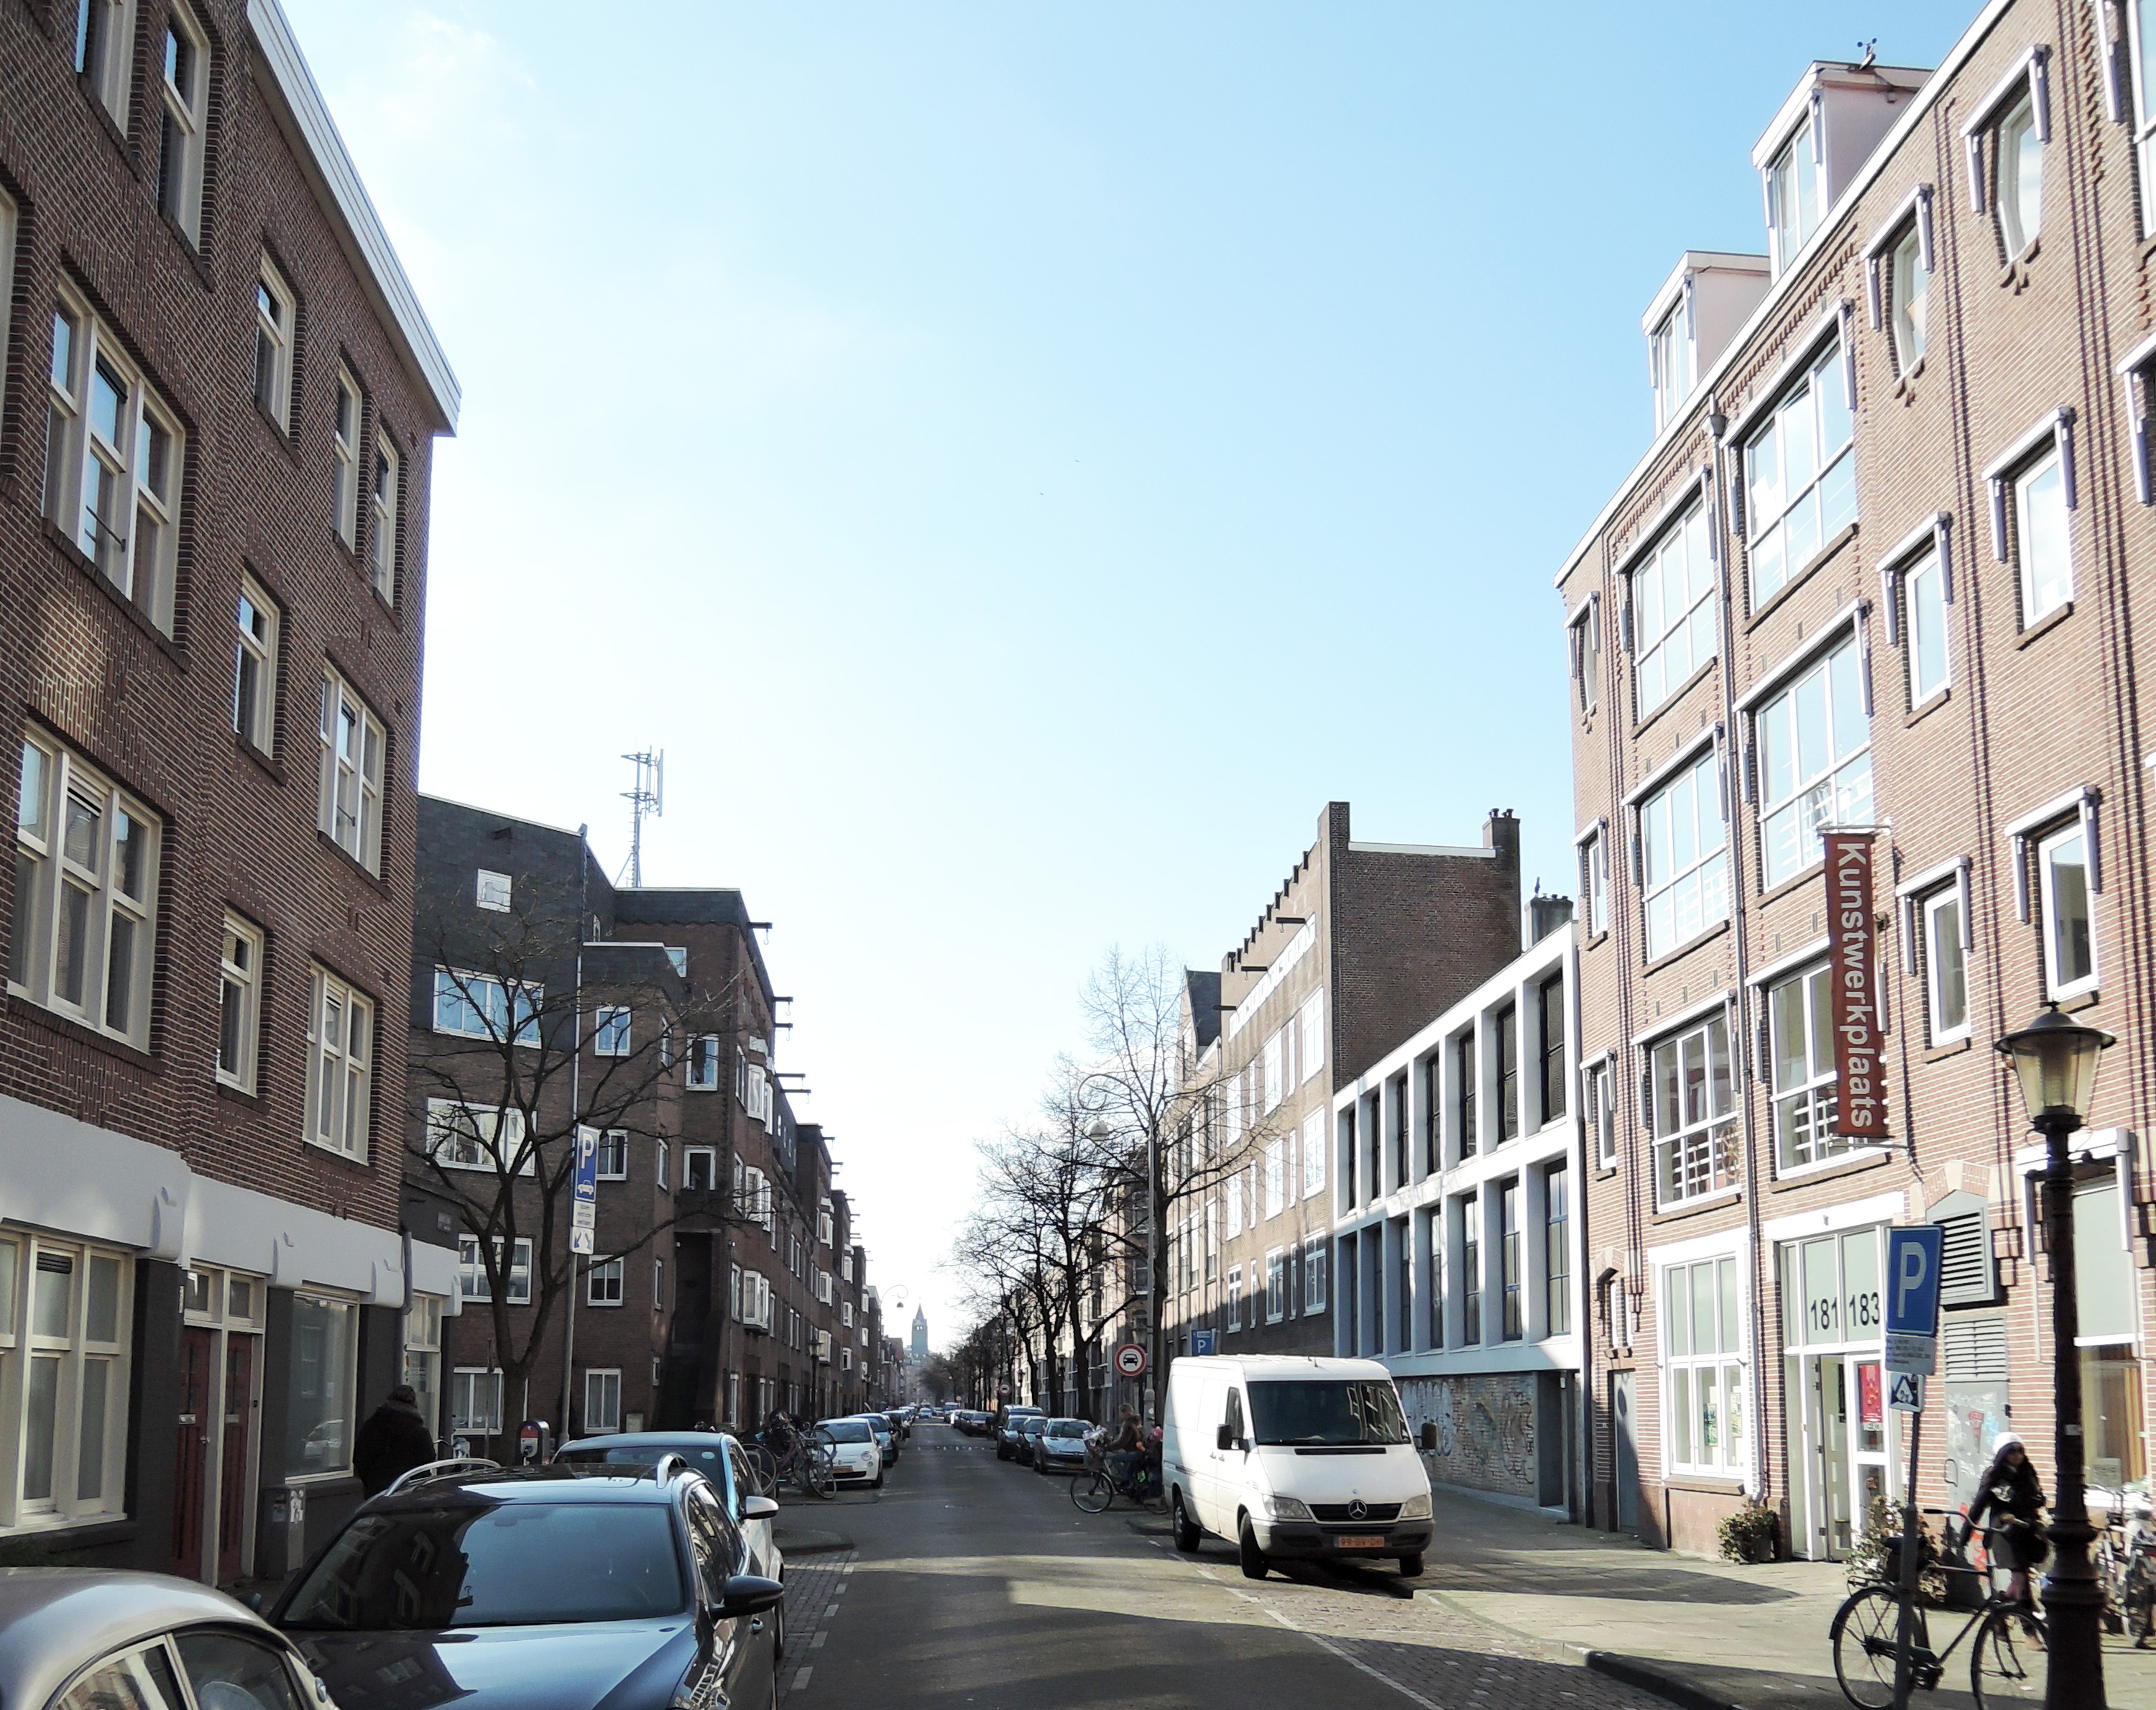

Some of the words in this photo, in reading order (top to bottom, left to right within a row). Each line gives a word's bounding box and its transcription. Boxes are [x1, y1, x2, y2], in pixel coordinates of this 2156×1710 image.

[1836, 842, 1875, 1128] Kunstwerkplaats
[581, 1133, 594, 1169] P
[1897, 1241, 1927, 1319] P
[1810, 1297, 1838, 1330] 181
[1849, 1292, 1880, 1327] 183
[1197, 1339, 1207, 1353] P
